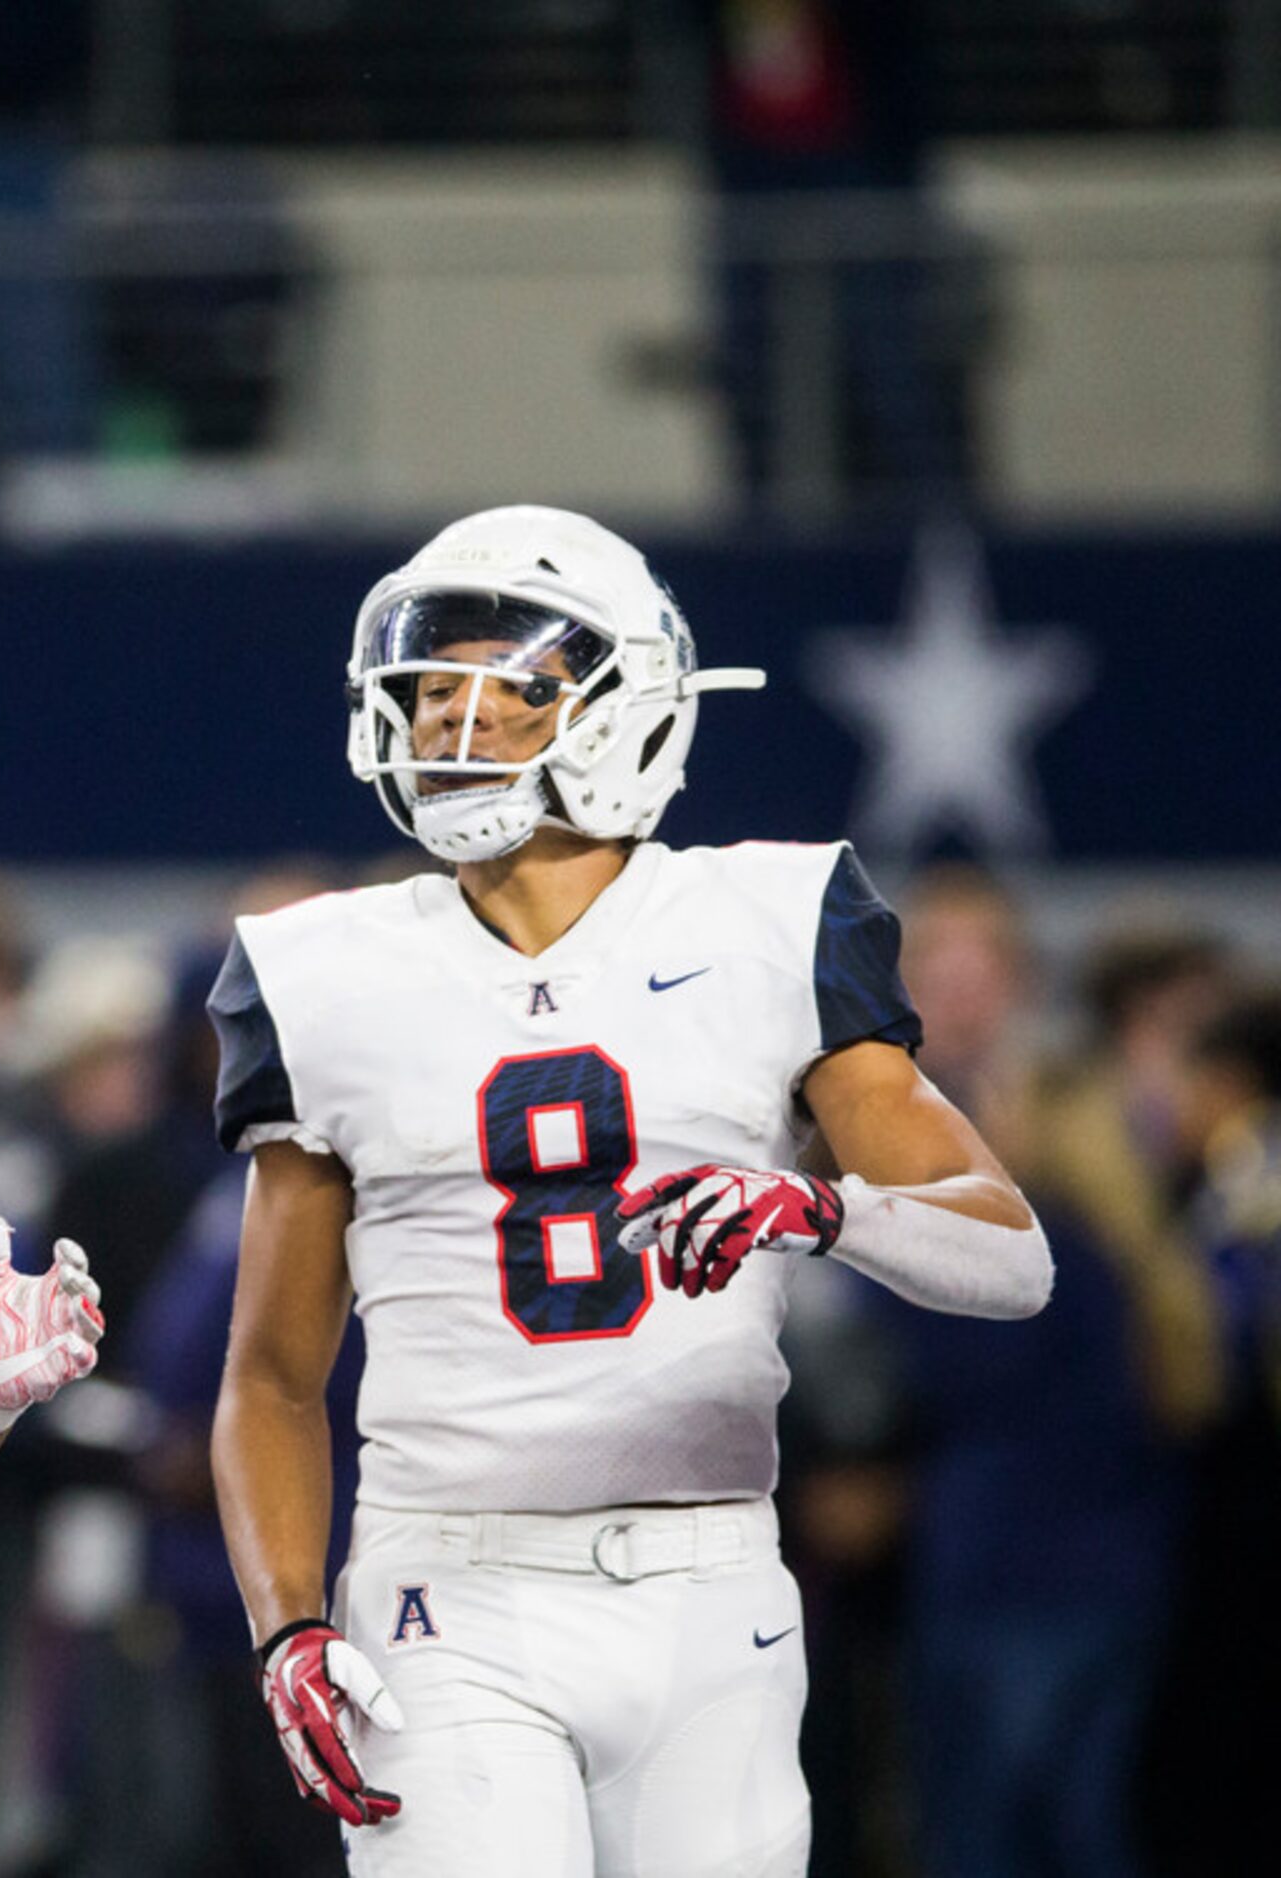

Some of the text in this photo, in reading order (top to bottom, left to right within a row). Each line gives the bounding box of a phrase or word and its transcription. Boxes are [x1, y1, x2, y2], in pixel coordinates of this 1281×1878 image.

[527, 980, 559, 1016] A
[477, 1043, 654, 1345] 8
[388, 1583, 442, 1645] A
